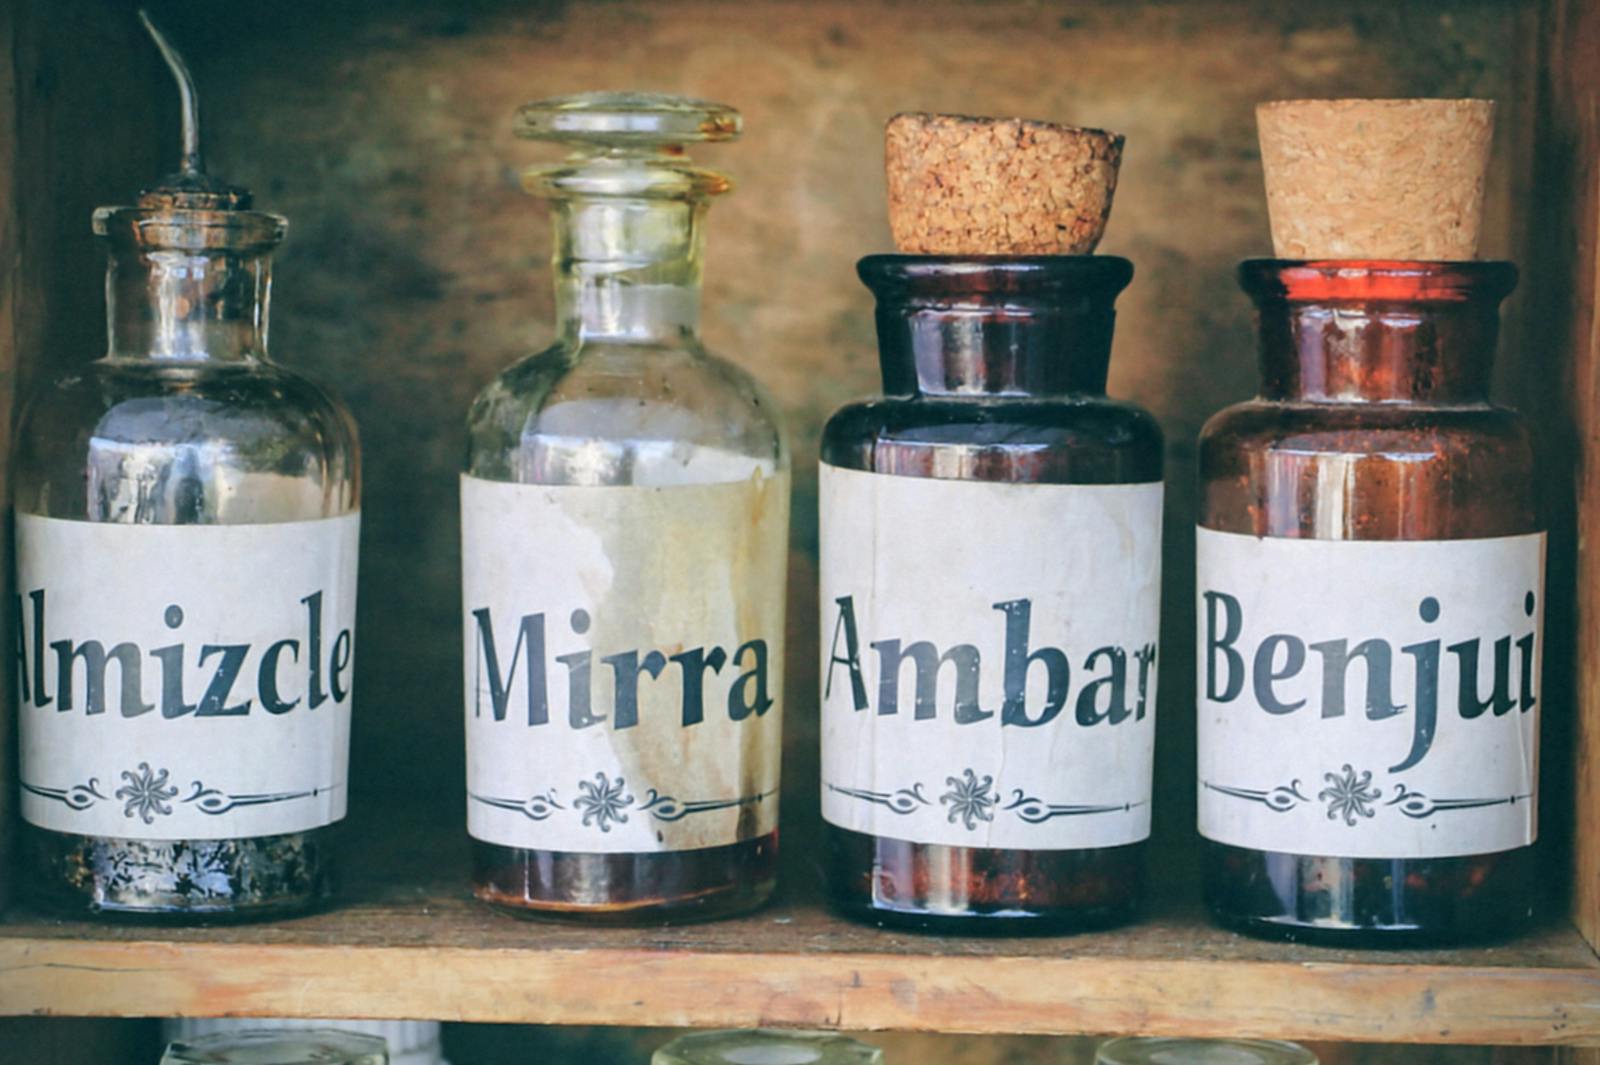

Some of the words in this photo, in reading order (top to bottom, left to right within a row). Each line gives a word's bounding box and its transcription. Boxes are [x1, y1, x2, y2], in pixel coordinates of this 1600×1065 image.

[472, 607, 774, 730] Mirra
[825, 595, 1156, 728] Ambar
[1203, 590, 1537, 774] Benjui
